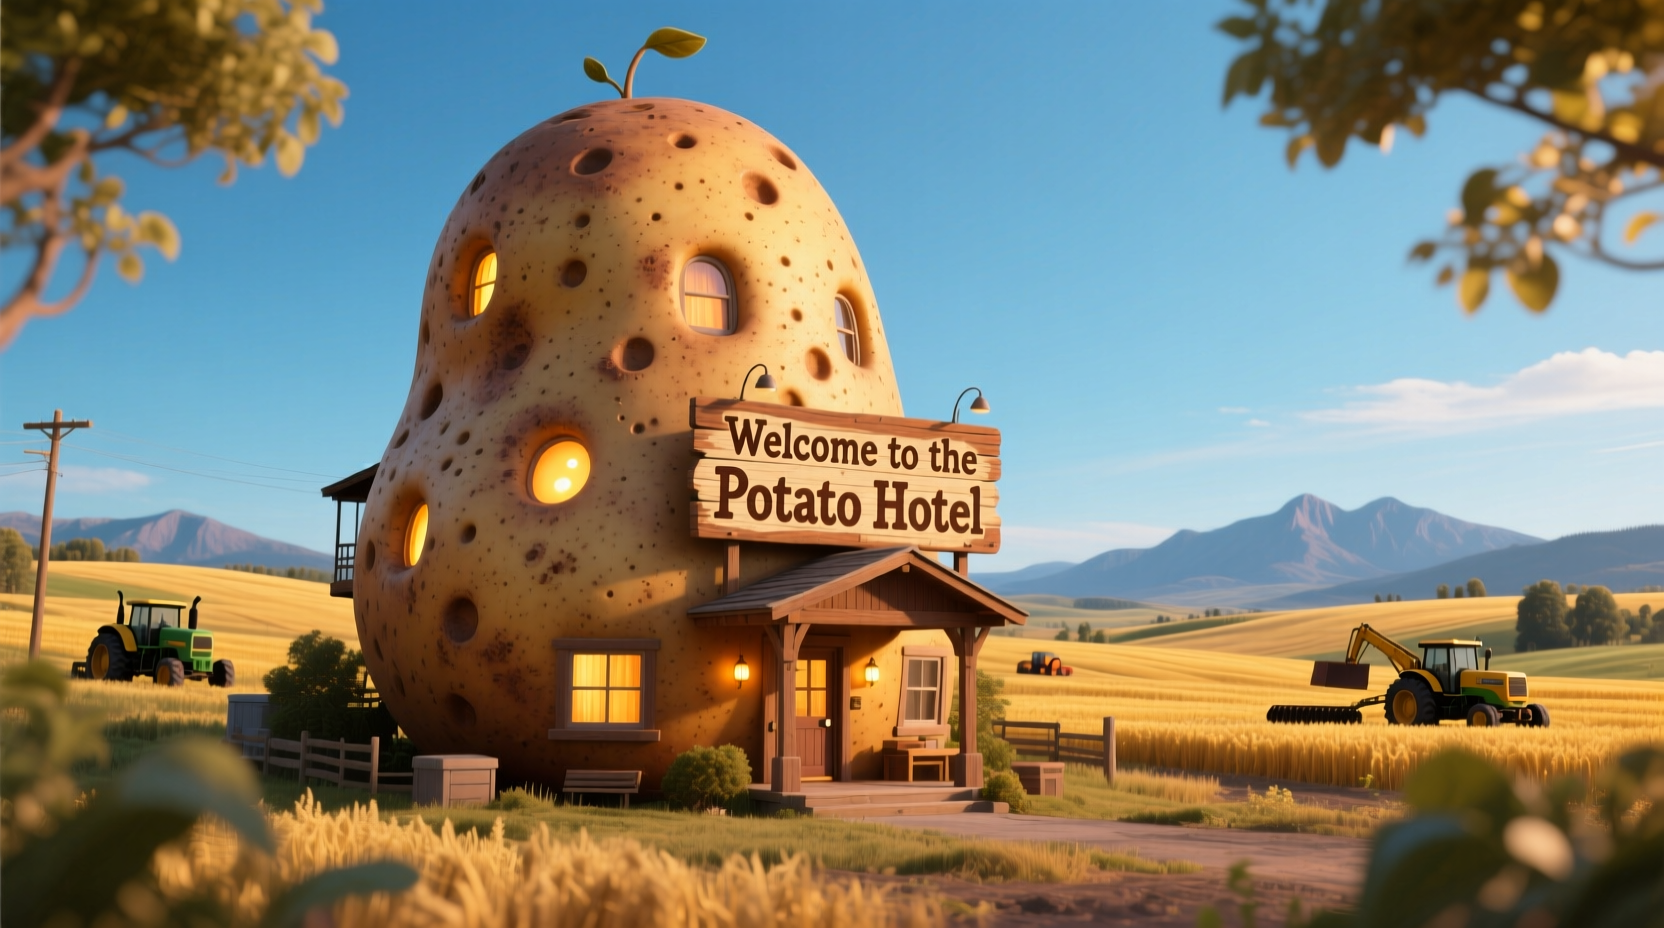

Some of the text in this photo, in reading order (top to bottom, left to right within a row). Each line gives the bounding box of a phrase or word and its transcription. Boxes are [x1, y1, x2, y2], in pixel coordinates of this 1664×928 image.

[724, 415, 978, 476] Welcome to the
[713, 465, 984, 535] Potato Hotel
